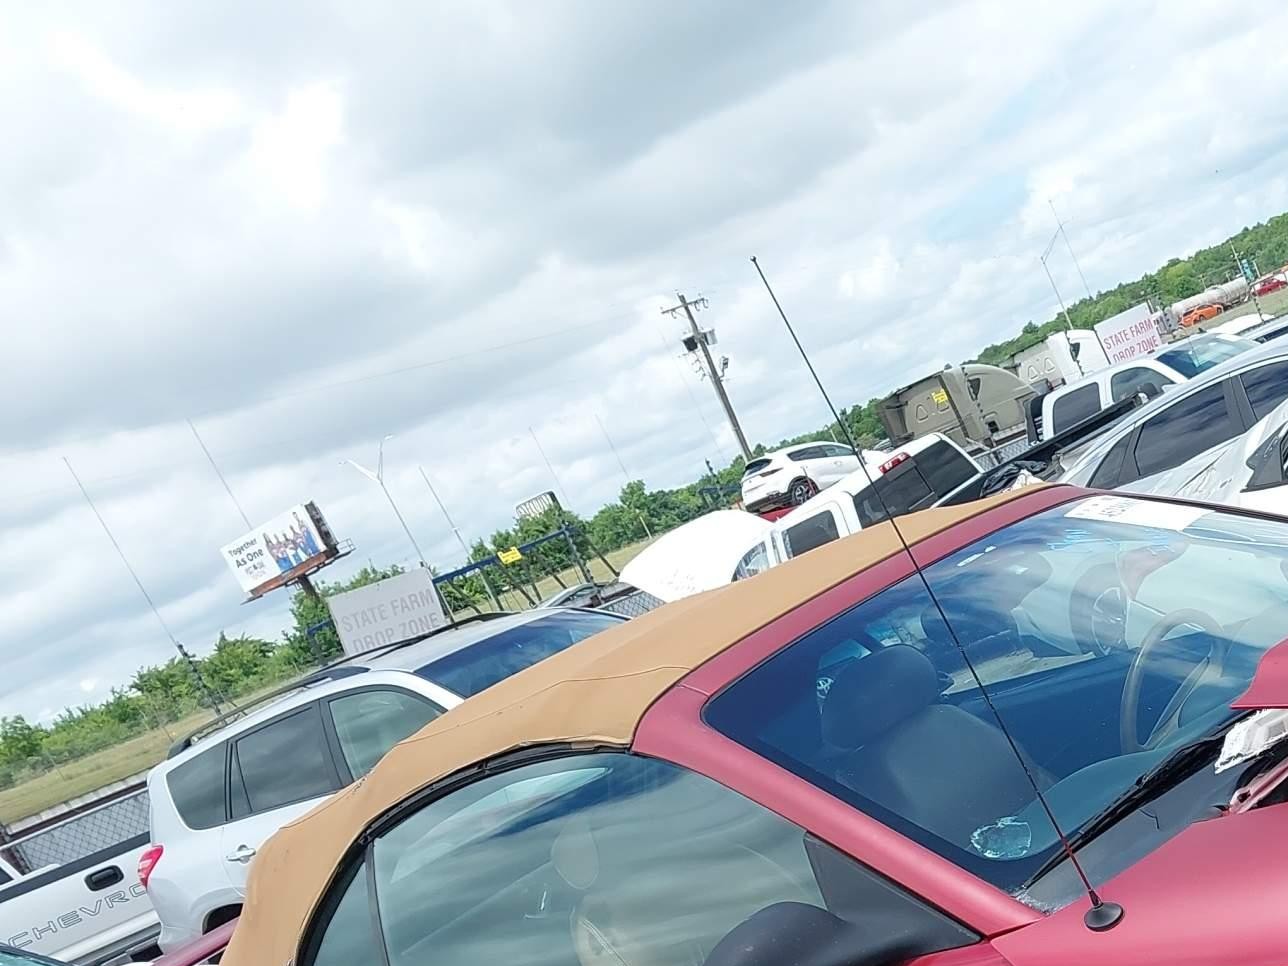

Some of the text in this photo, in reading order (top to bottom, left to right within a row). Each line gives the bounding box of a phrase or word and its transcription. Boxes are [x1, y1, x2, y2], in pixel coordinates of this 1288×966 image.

[1103, 318, 1154, 350] STATE FARM
[1113, 335, 1159, 363] DROP ZONE
[228, 538, 258, 557] Together
[235, 548, 264, 568] As One
[341, 588, 435, 633] STATE FARM
[352, 612, 441, 652] DROP ZONE
